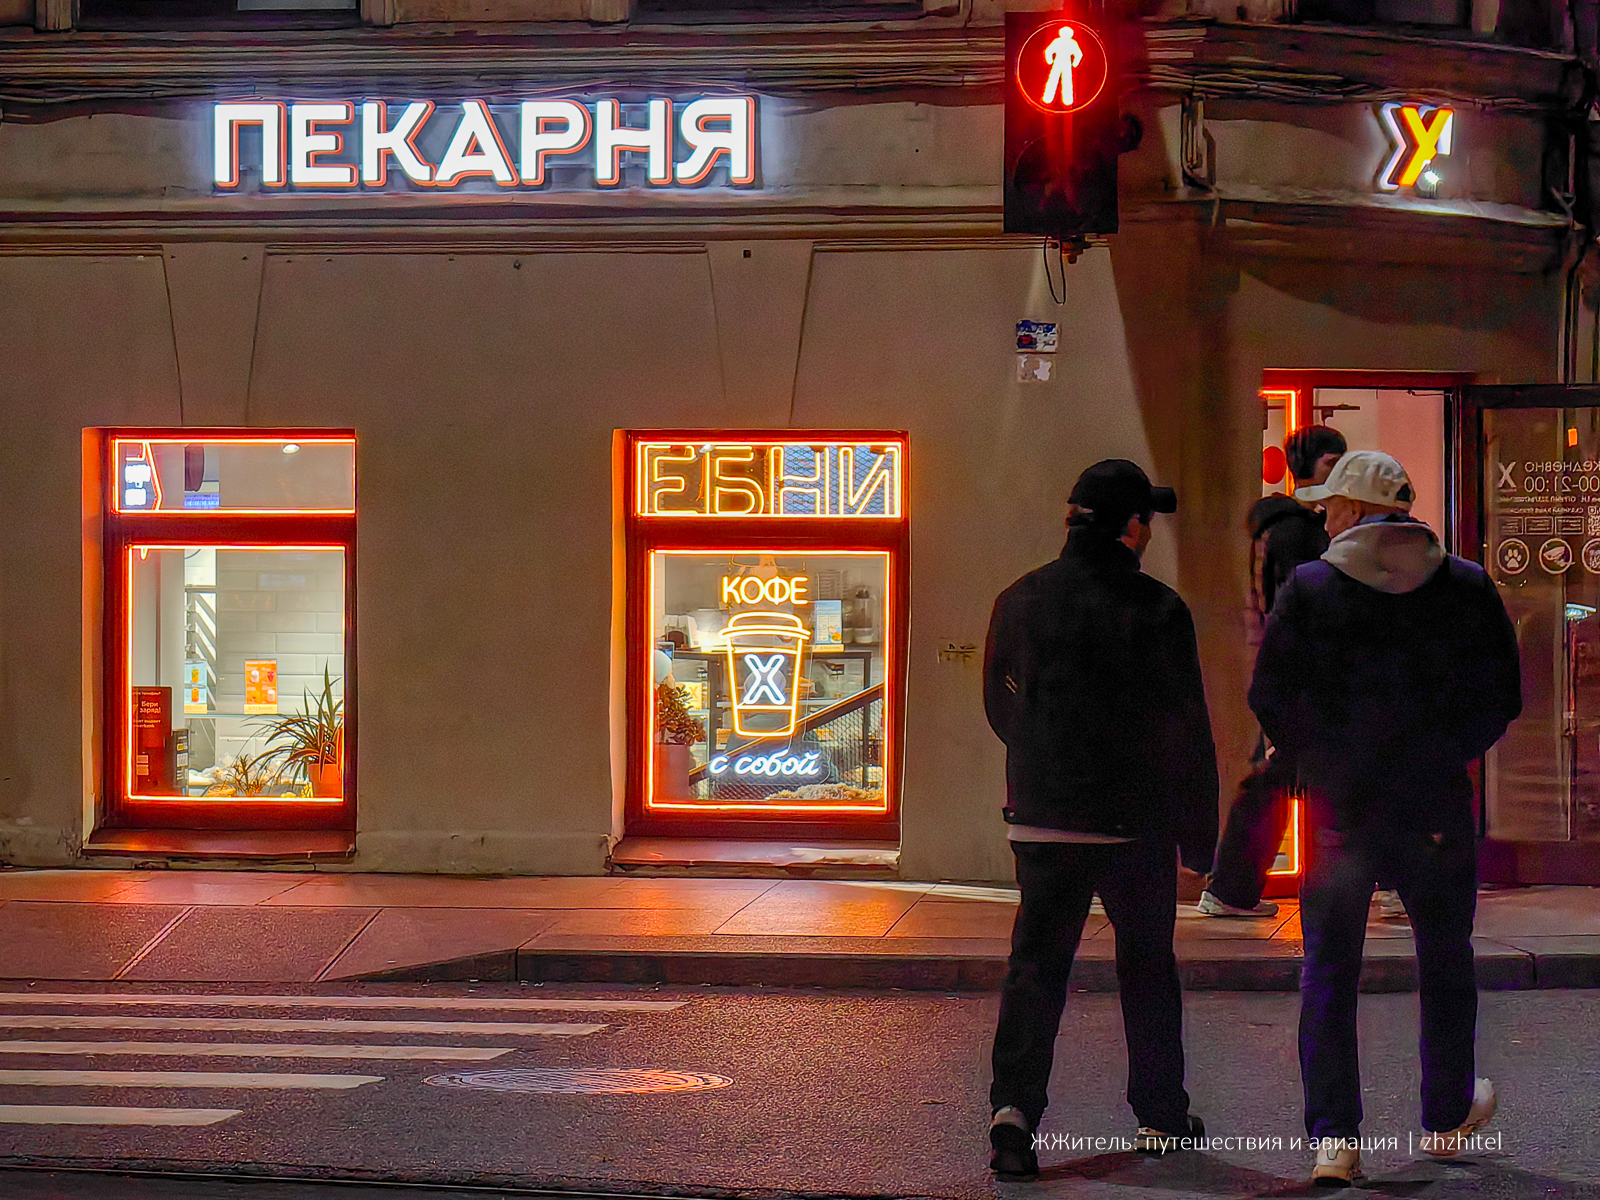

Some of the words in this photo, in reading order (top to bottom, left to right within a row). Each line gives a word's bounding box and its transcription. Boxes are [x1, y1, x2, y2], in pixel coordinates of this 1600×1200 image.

[213, 99, 754, 187] ПЕКАРНЯ
[722, 576, 809, 605] КОФЕ
[734, 748, 822, 777] собой
